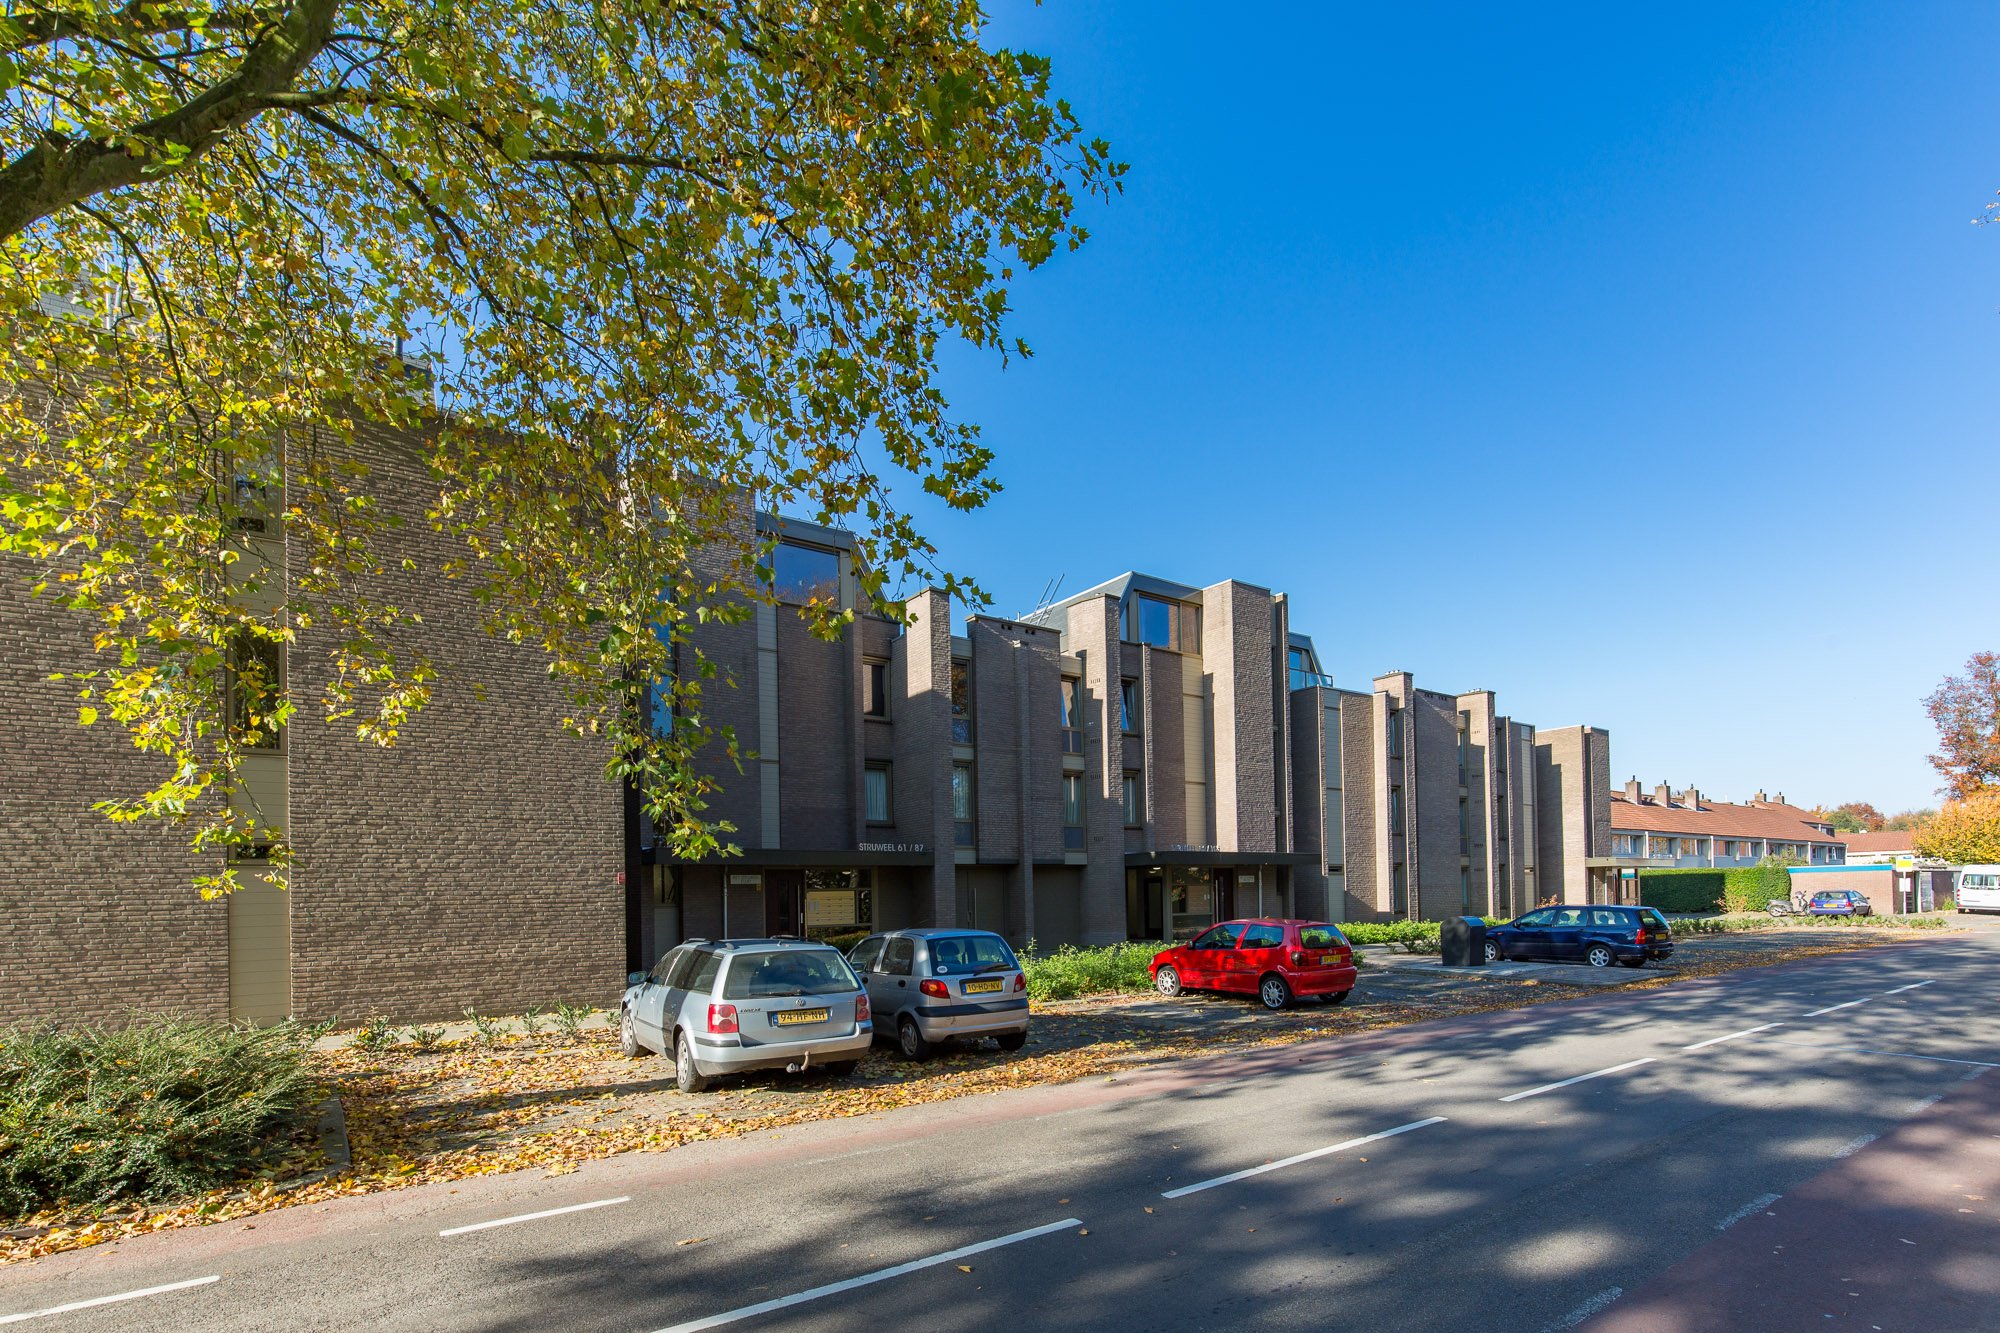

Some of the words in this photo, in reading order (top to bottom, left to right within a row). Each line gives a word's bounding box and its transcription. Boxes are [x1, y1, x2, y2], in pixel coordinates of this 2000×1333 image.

[858, 842, 896, 852] STRUWEEL
[897, 843, 907, 852] 61
[914, 843, 924, 852] 87
[780, 1010, 825, 1022] 94-HF-NH
